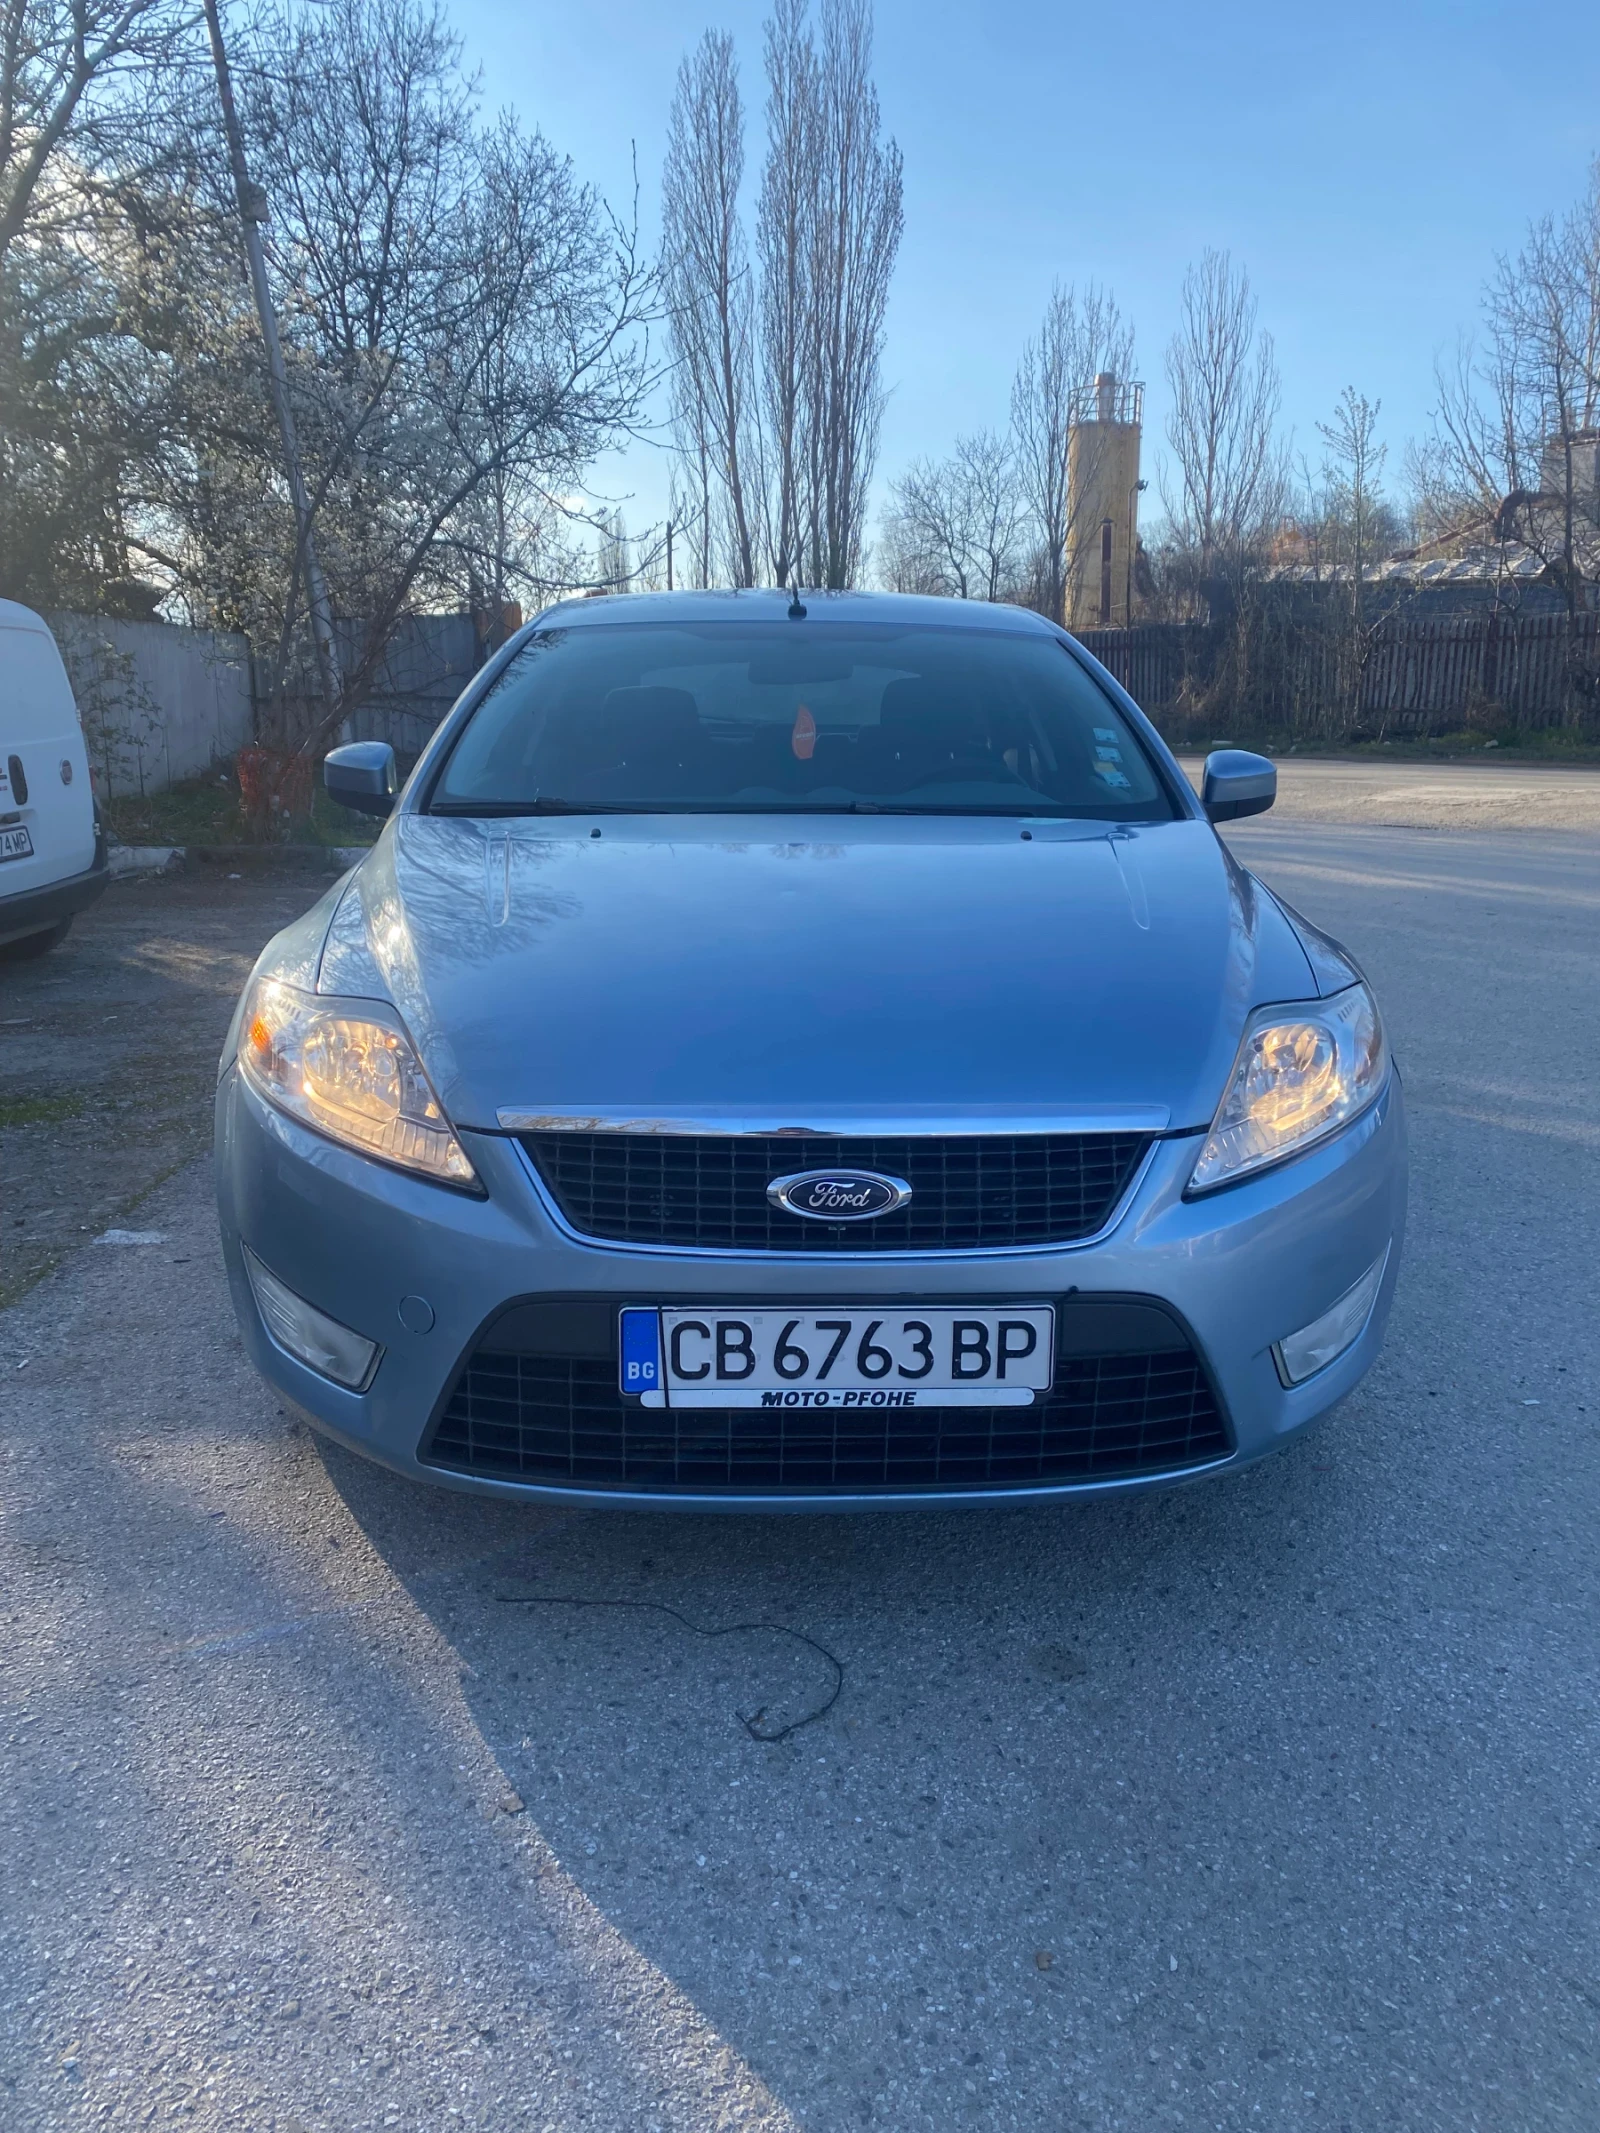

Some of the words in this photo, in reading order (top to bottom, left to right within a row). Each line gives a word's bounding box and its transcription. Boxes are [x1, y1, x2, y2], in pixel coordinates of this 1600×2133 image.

[809, 1181, 871, 1207] Ford
[670, 1320, 756, 1380] CB
[773, 1320, 935, 1380] 6763
[951, 1320, 1037, 1380] BP
[627, 1361, 655, 1380] BG
